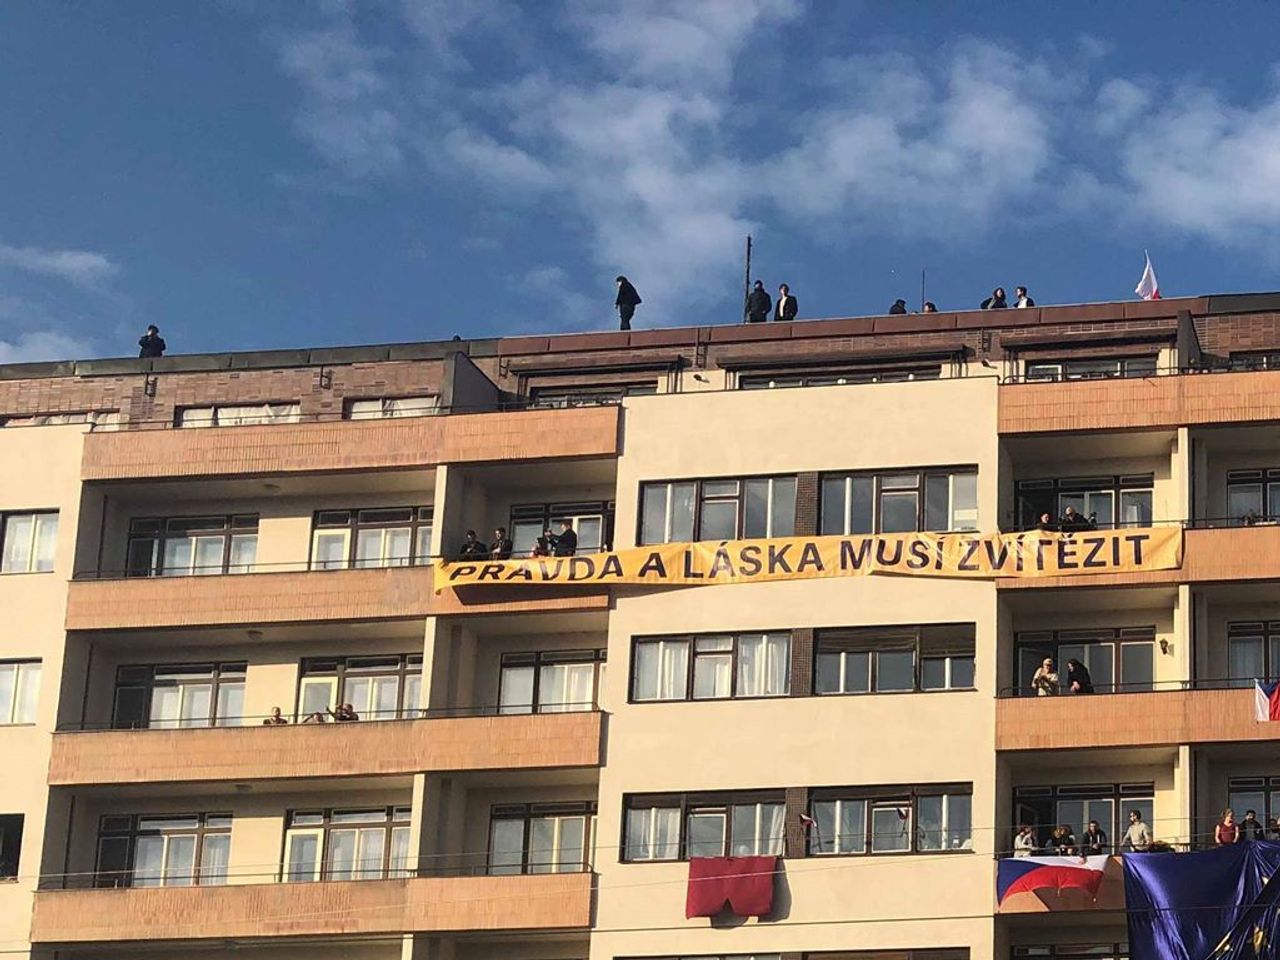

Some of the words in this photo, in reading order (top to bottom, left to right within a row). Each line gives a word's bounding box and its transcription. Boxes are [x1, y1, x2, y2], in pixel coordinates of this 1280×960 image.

[449, 554, 624, 581] PRAVDA
[638, 552, 667, 578] A
[683, 541, 825, 579] LÁSKA
[840, 536, 945, 571] MUSÍ
[957, 532, 1150, 571] ZVÍTĚZIT
